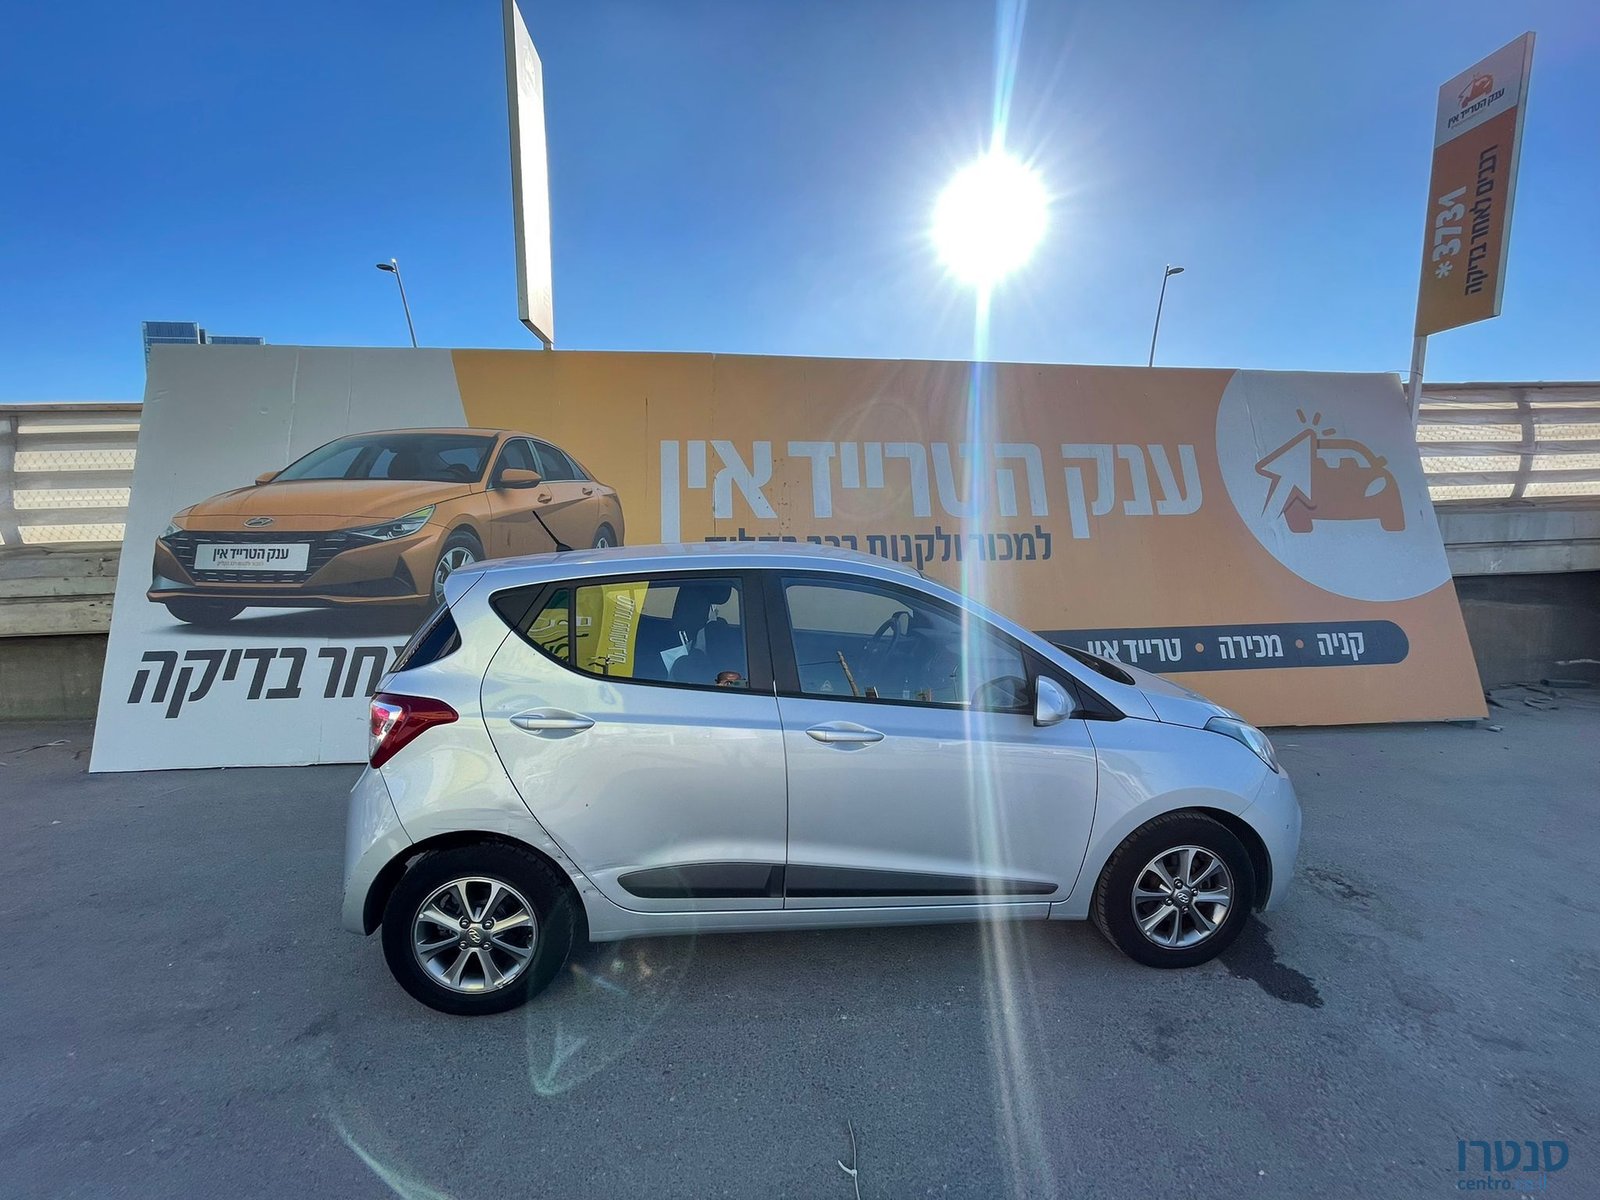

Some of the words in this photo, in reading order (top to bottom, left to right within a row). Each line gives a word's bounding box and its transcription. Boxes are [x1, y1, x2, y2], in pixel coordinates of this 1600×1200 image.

[1475, 144, 1498, 196] רכבים
[1469, 197, 1491, 245] לאחר
[1464, 242, 1488, 296] בדיקה
[659, 439, 778, 544] אין
[787, 441, 1049, 519] הטרייד
[1060, 443, 1203, 539] ענק
[213, 548, 229, 562] אין
[230, 548, 266, 560] הטרייד
[267, 548, 289, 562] ענק
[866, 525, 963, 570] ולקנות
[967, 525, 1052, 562] למכור
[1122, 638, 1182, 663] טרייד
[1218, 634, 1284, 660] מכירה
[1316, 632, 1365, 661] קניה
[127, 647, 307, 719] בדיקה
